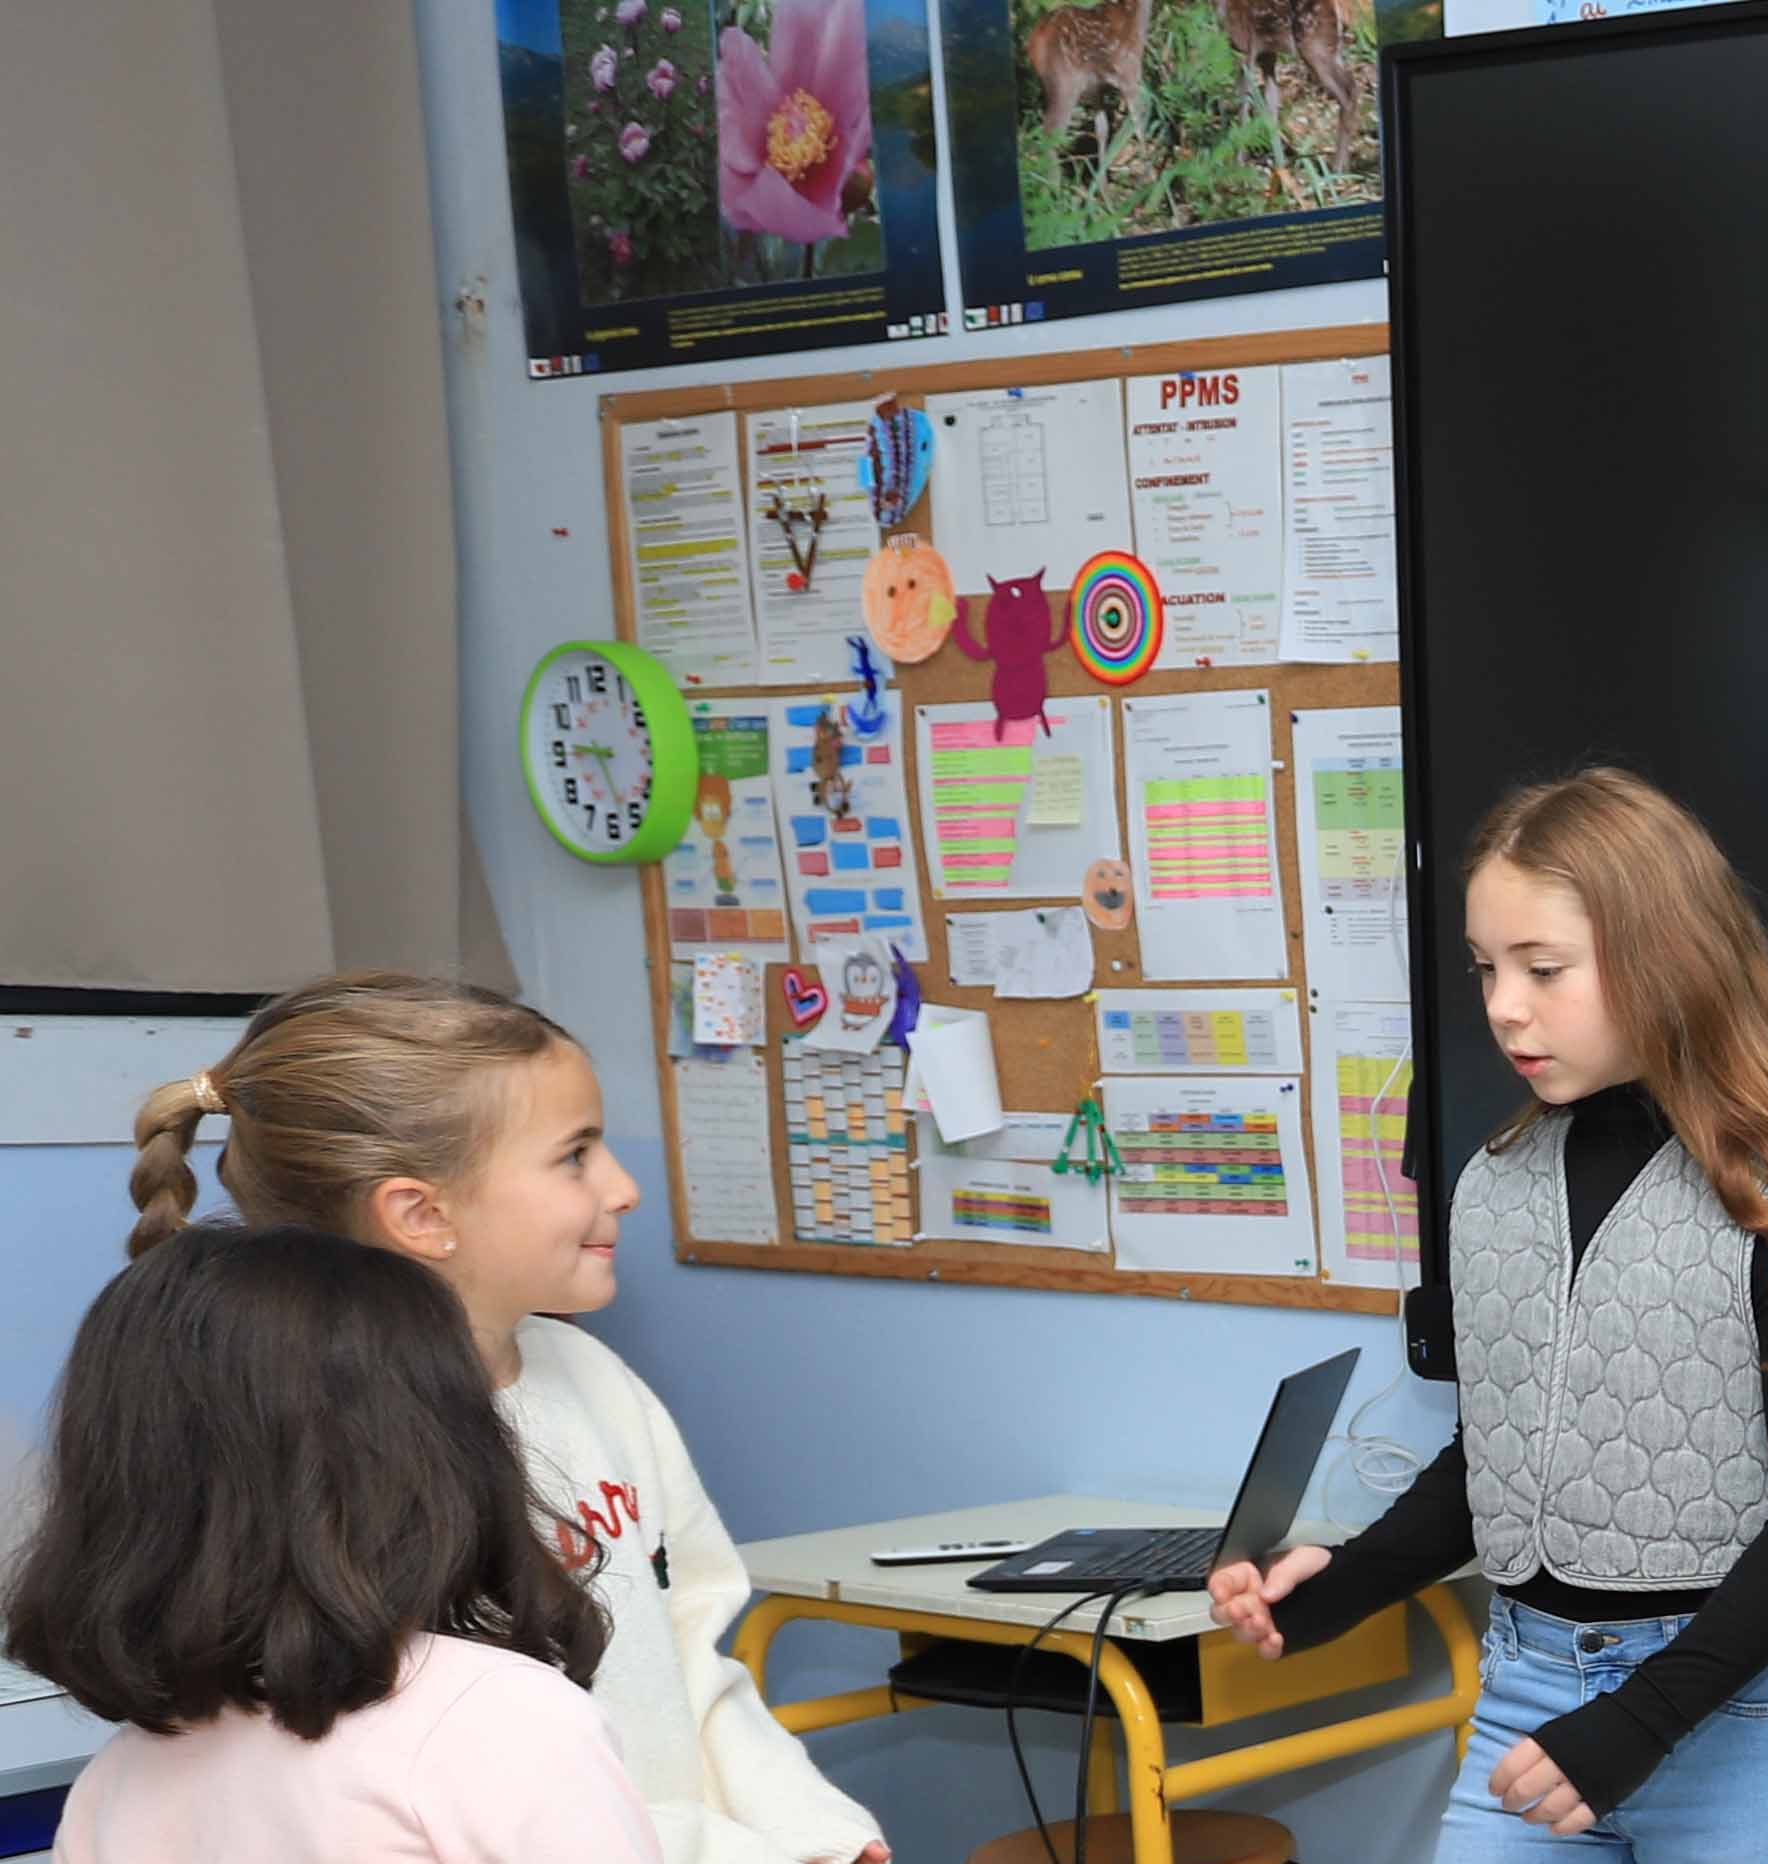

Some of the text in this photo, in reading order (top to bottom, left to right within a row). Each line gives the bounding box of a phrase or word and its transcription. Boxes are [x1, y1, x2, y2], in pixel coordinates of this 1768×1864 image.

[1160, 373, 1240, 410] PPMS
[1135, 472, 1211, 489] CONFINEMENT
[1160, 592, 1225, 607] ACUATION
[566, 675, 582, 702] 11
[586, 665, 607, 693] 12
[616, 674, 625, 702] 1
[553, 703, 571, 731] 10
[553, 740, 566, 768] 9
[564, 778, 578, 805] 8
[583, 803, 596, 831] 7
[606, 812, 620, 840] 6
[628, 801, 642, 830] 5
